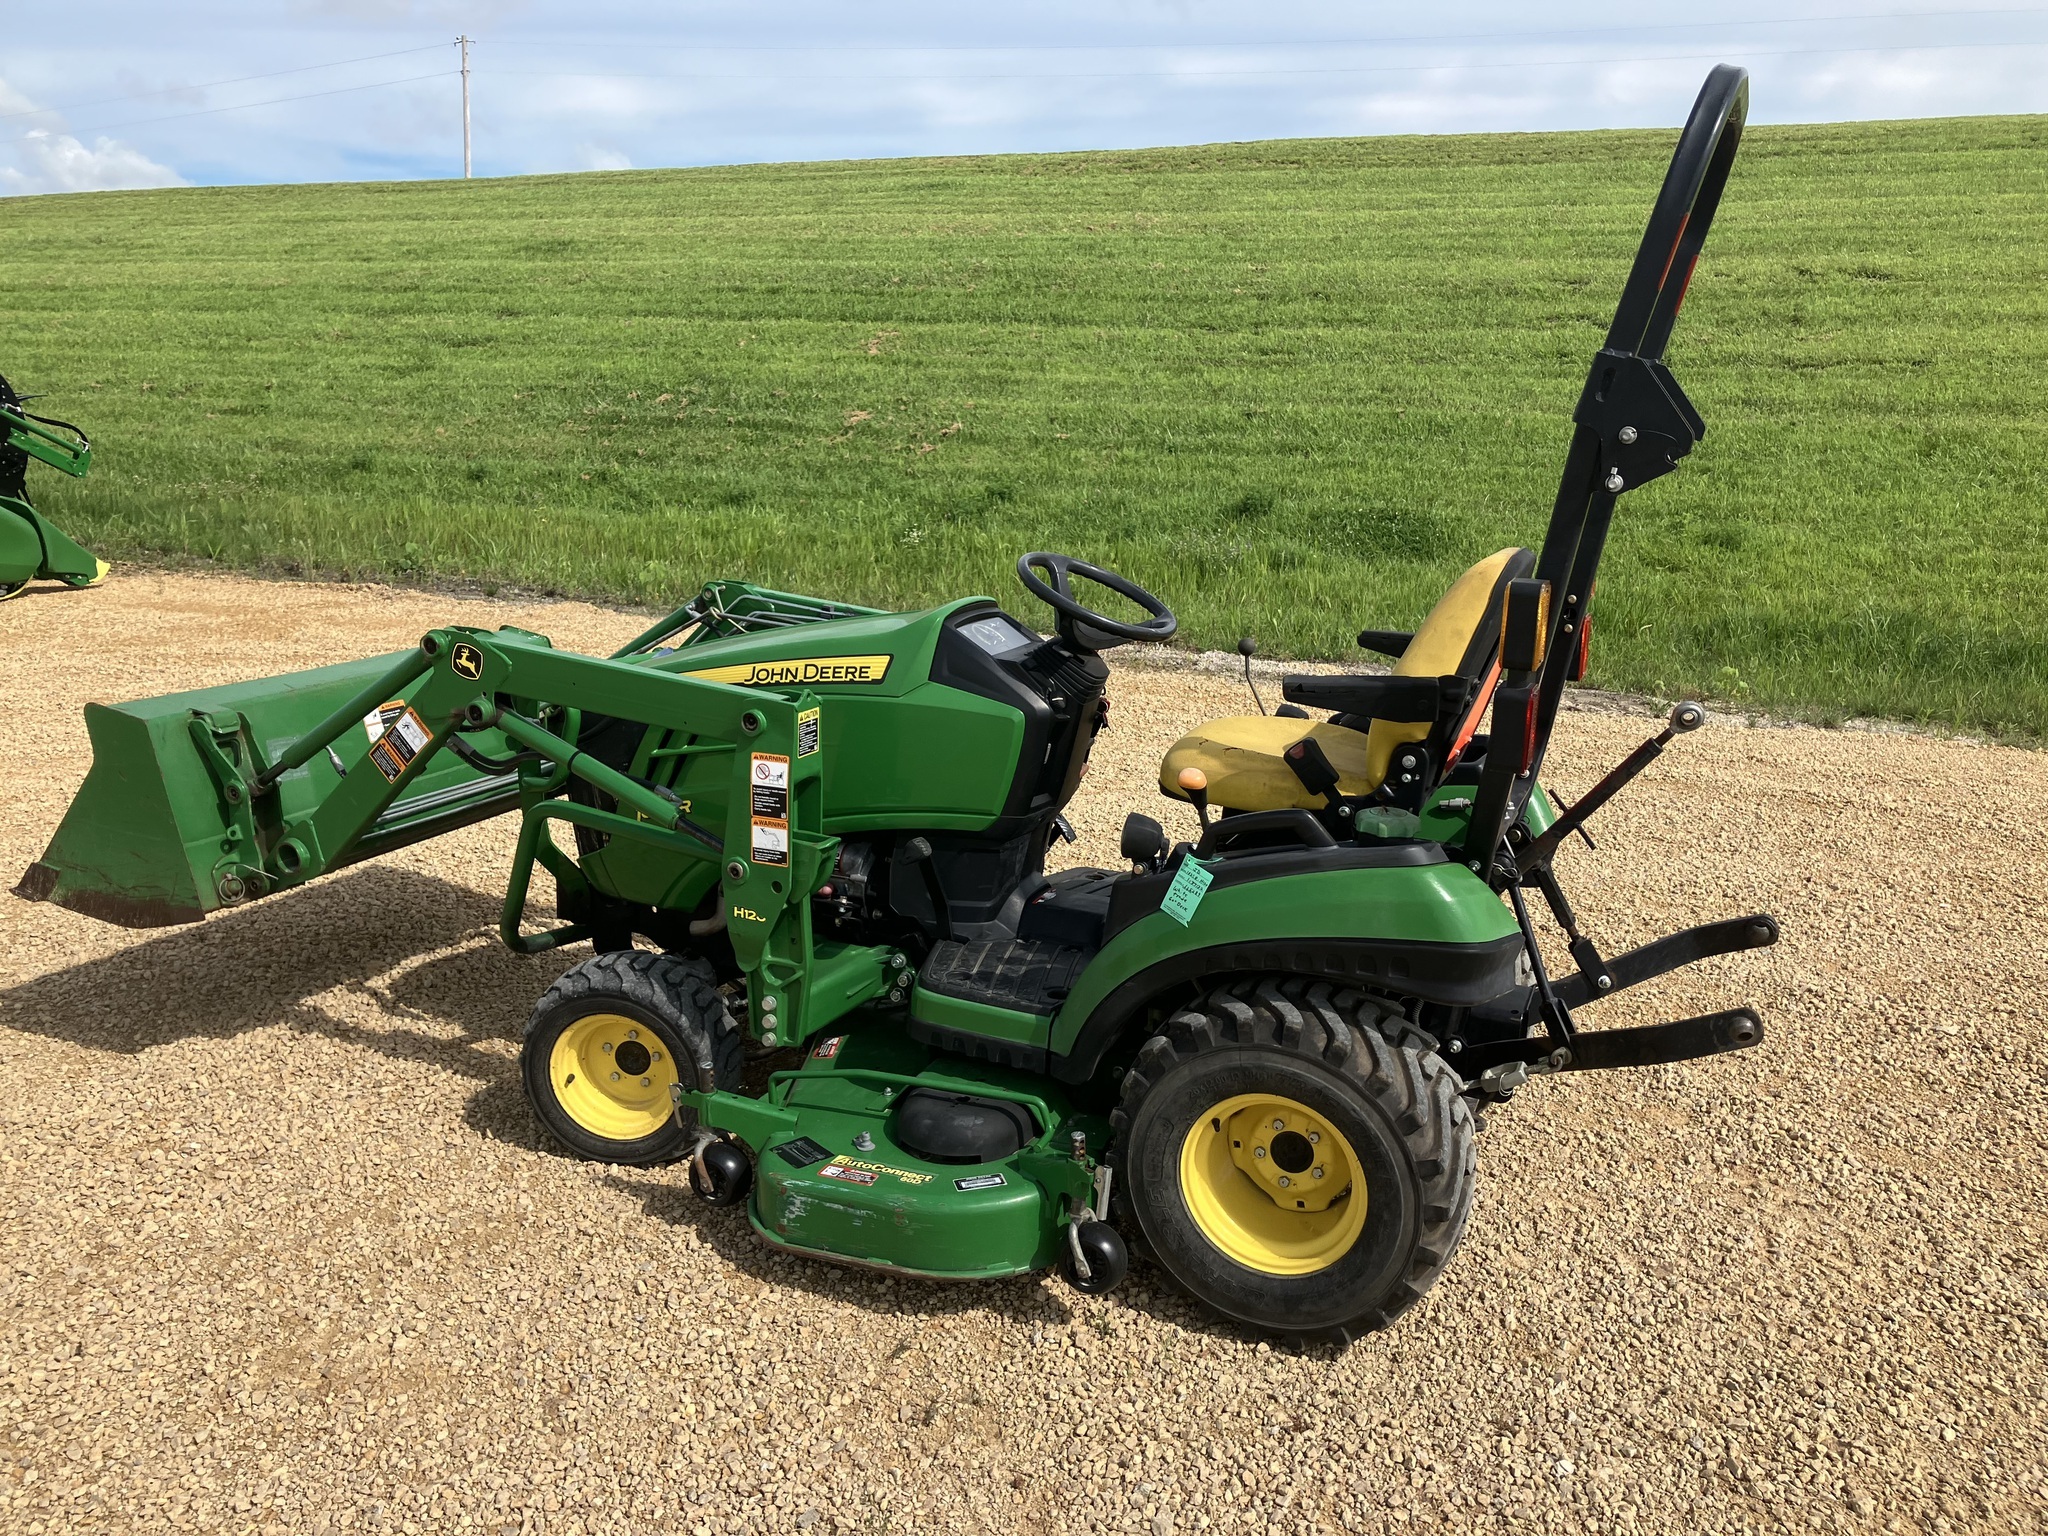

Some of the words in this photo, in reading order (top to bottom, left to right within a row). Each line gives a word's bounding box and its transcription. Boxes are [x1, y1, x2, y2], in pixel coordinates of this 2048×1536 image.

[744, 665, 799, 683] JOHN
[803, 663, 871, 681] DEERE
[759, 754, 788, 763] WARNING
[759, 820, 787, 829] WARNING
[832, 1155, 933, 1182] AutoConnect
